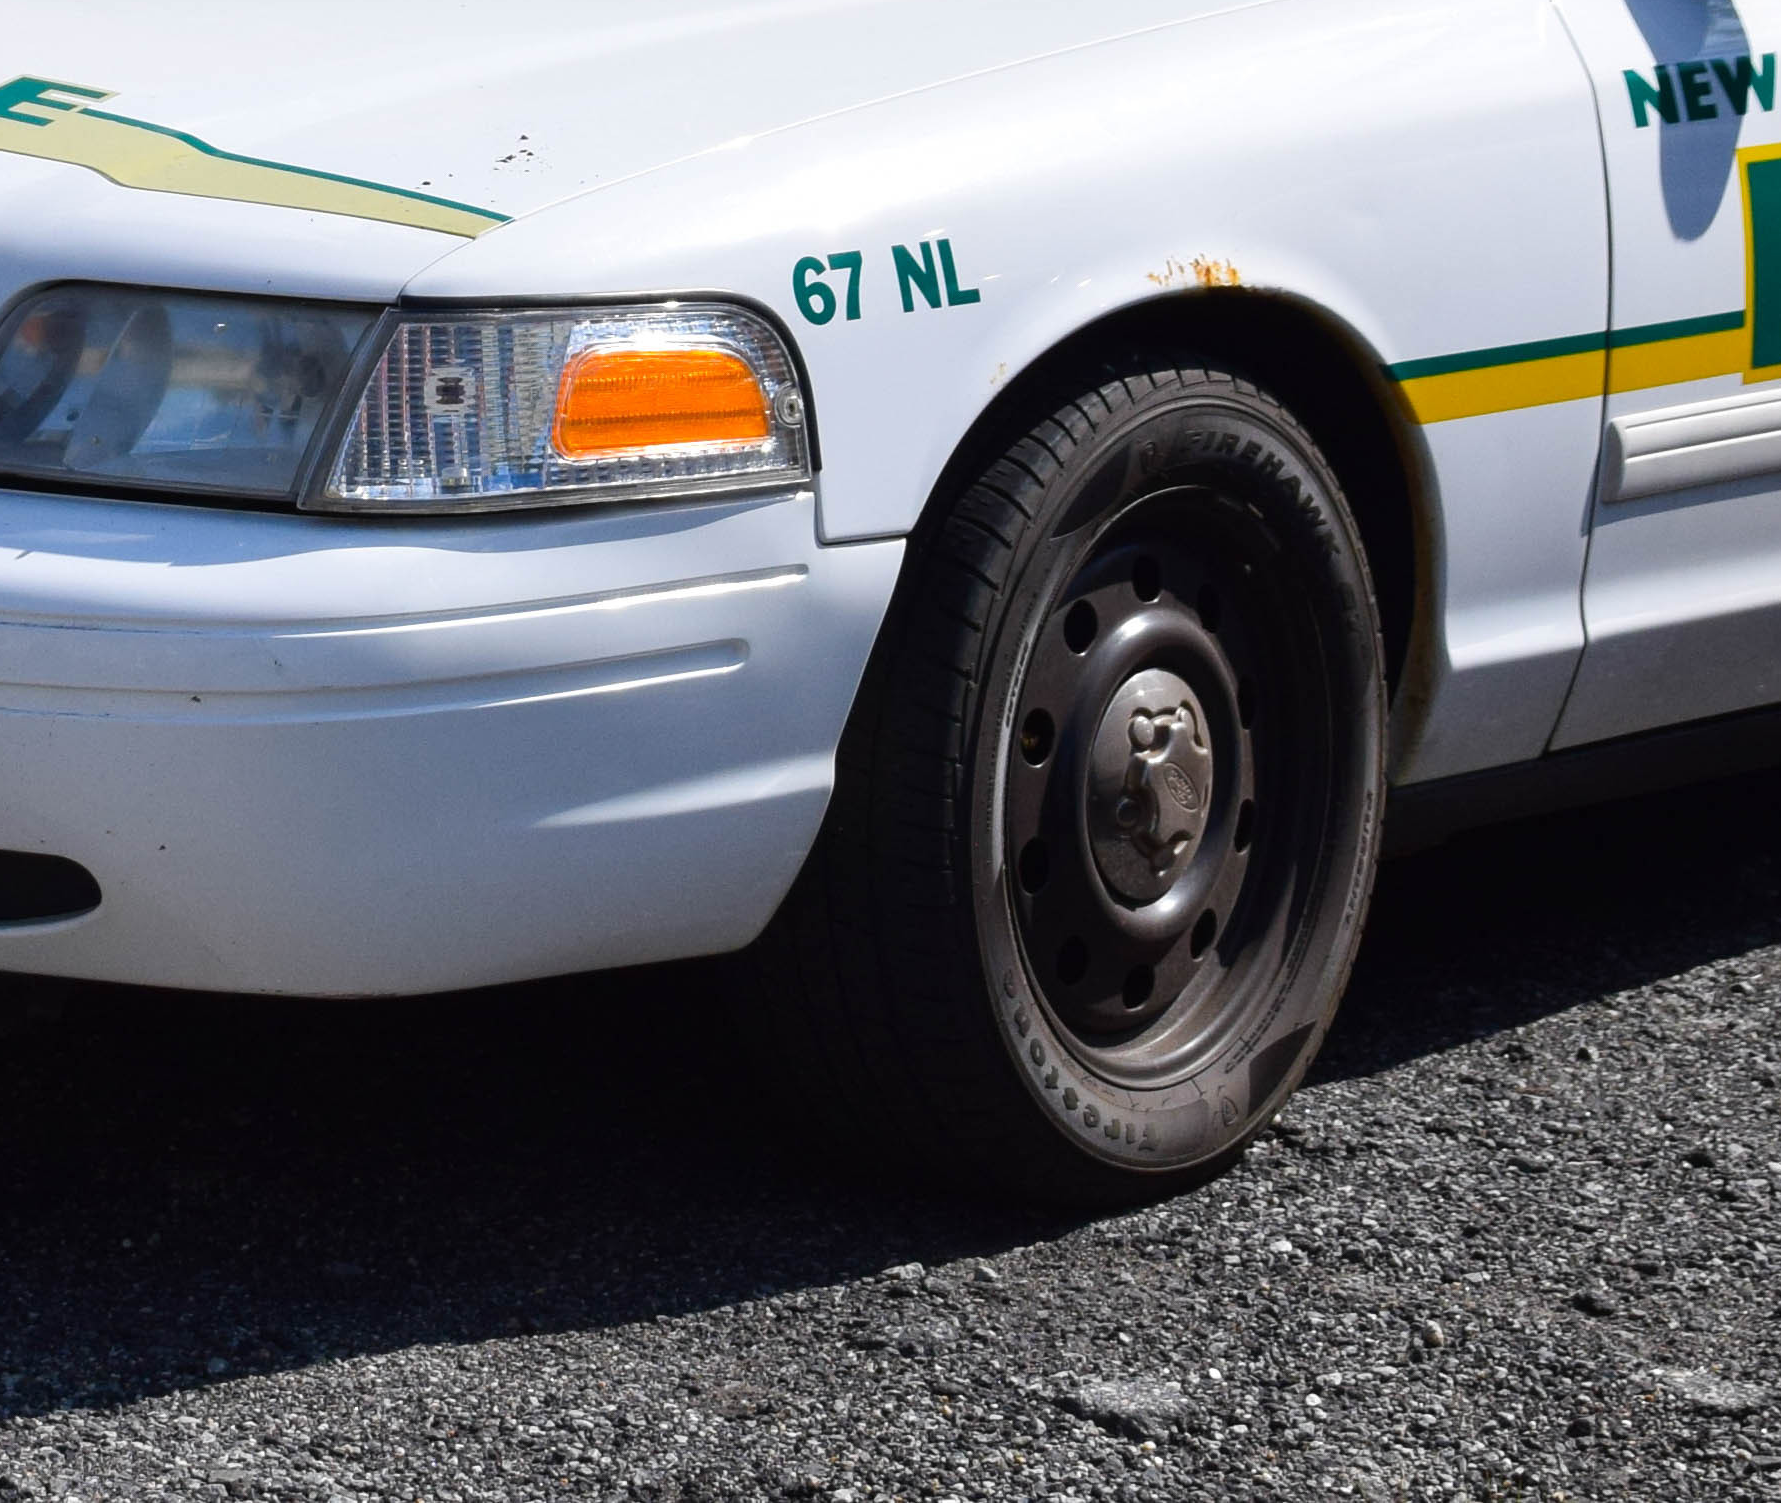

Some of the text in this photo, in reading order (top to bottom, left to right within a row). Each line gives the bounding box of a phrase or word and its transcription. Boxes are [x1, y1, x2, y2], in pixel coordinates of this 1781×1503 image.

[1622, 52, 1776, 128] NEW
[792, 238, 981, 326] 67 NL
[1184, 429, 1341, 564] FIREHAWK
